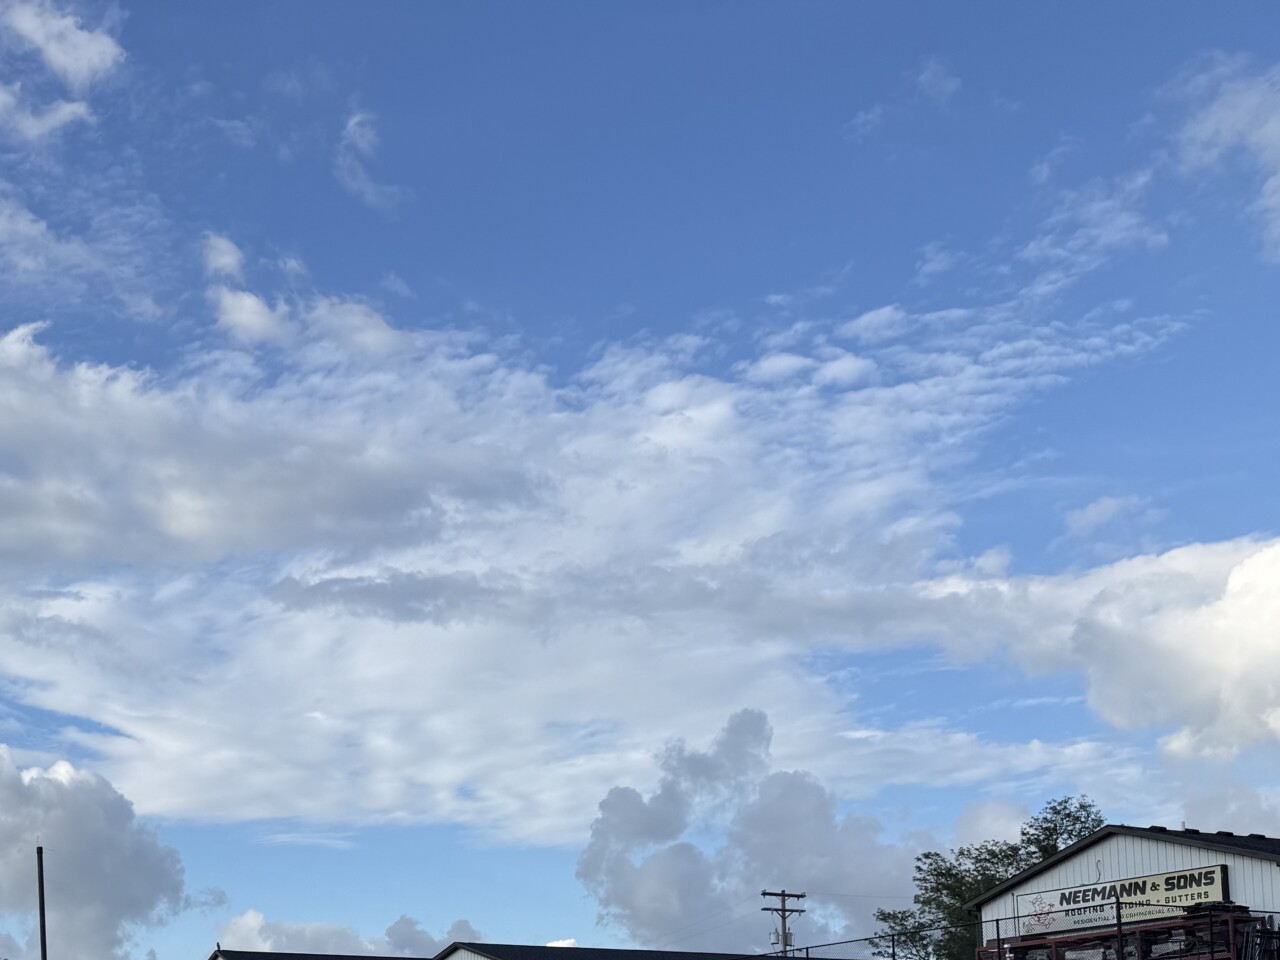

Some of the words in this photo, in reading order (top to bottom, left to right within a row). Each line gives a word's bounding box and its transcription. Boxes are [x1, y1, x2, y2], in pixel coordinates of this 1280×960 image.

[1059, 880, 1147, 906] NEEMANN
[1150, 881, 1161, 891] &
[1164, 870, 1216, 892] SONS
[1064, 905, 1105, 917] ROOFING
[1119, 899, 1151, 910] SIDING
[1165, 891, 1209, 904] GUTTERS
[1125, 907, 1166, 919] COMMERCIAL
